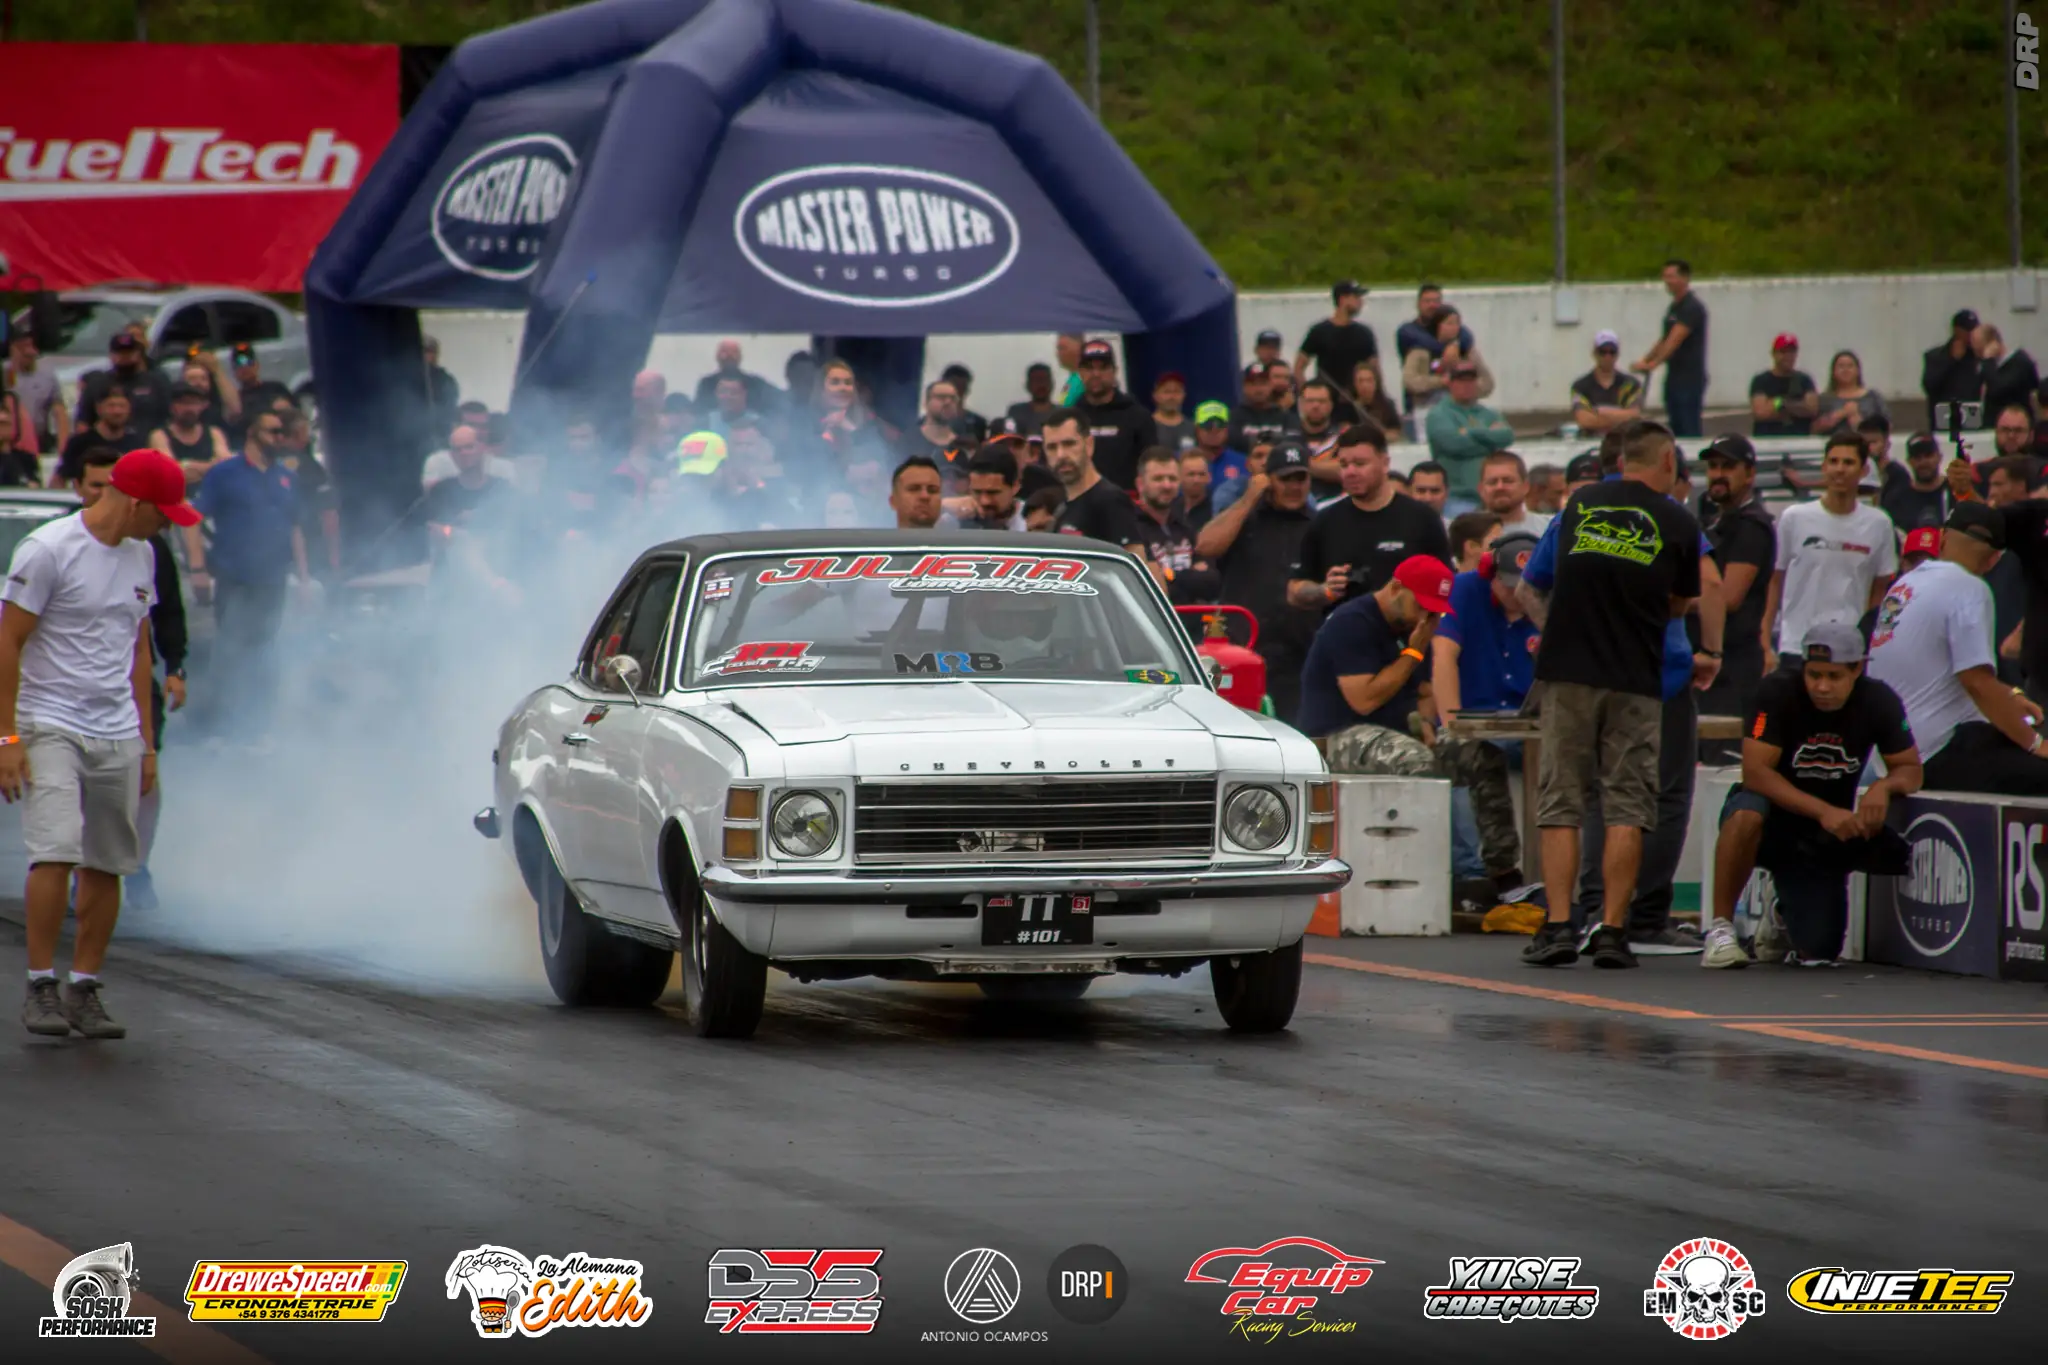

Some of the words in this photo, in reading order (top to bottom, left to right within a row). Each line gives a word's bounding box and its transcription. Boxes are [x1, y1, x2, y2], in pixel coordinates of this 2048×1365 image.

[756, 188, 878, 254] MASTER
[877, 188, 995, 254] POWER
[814, 265, 951, 281] TURBO
[757, 554, 1089, 584] JULIETA
[893, 651, 1004, 674] MRB
[900, 759, 1174, 771] CHEVROLET
[2006, 822, 2047, 930] RS
[1018, 894, 1062, 922] TT
[1017, 930, 1060, 944] #101
